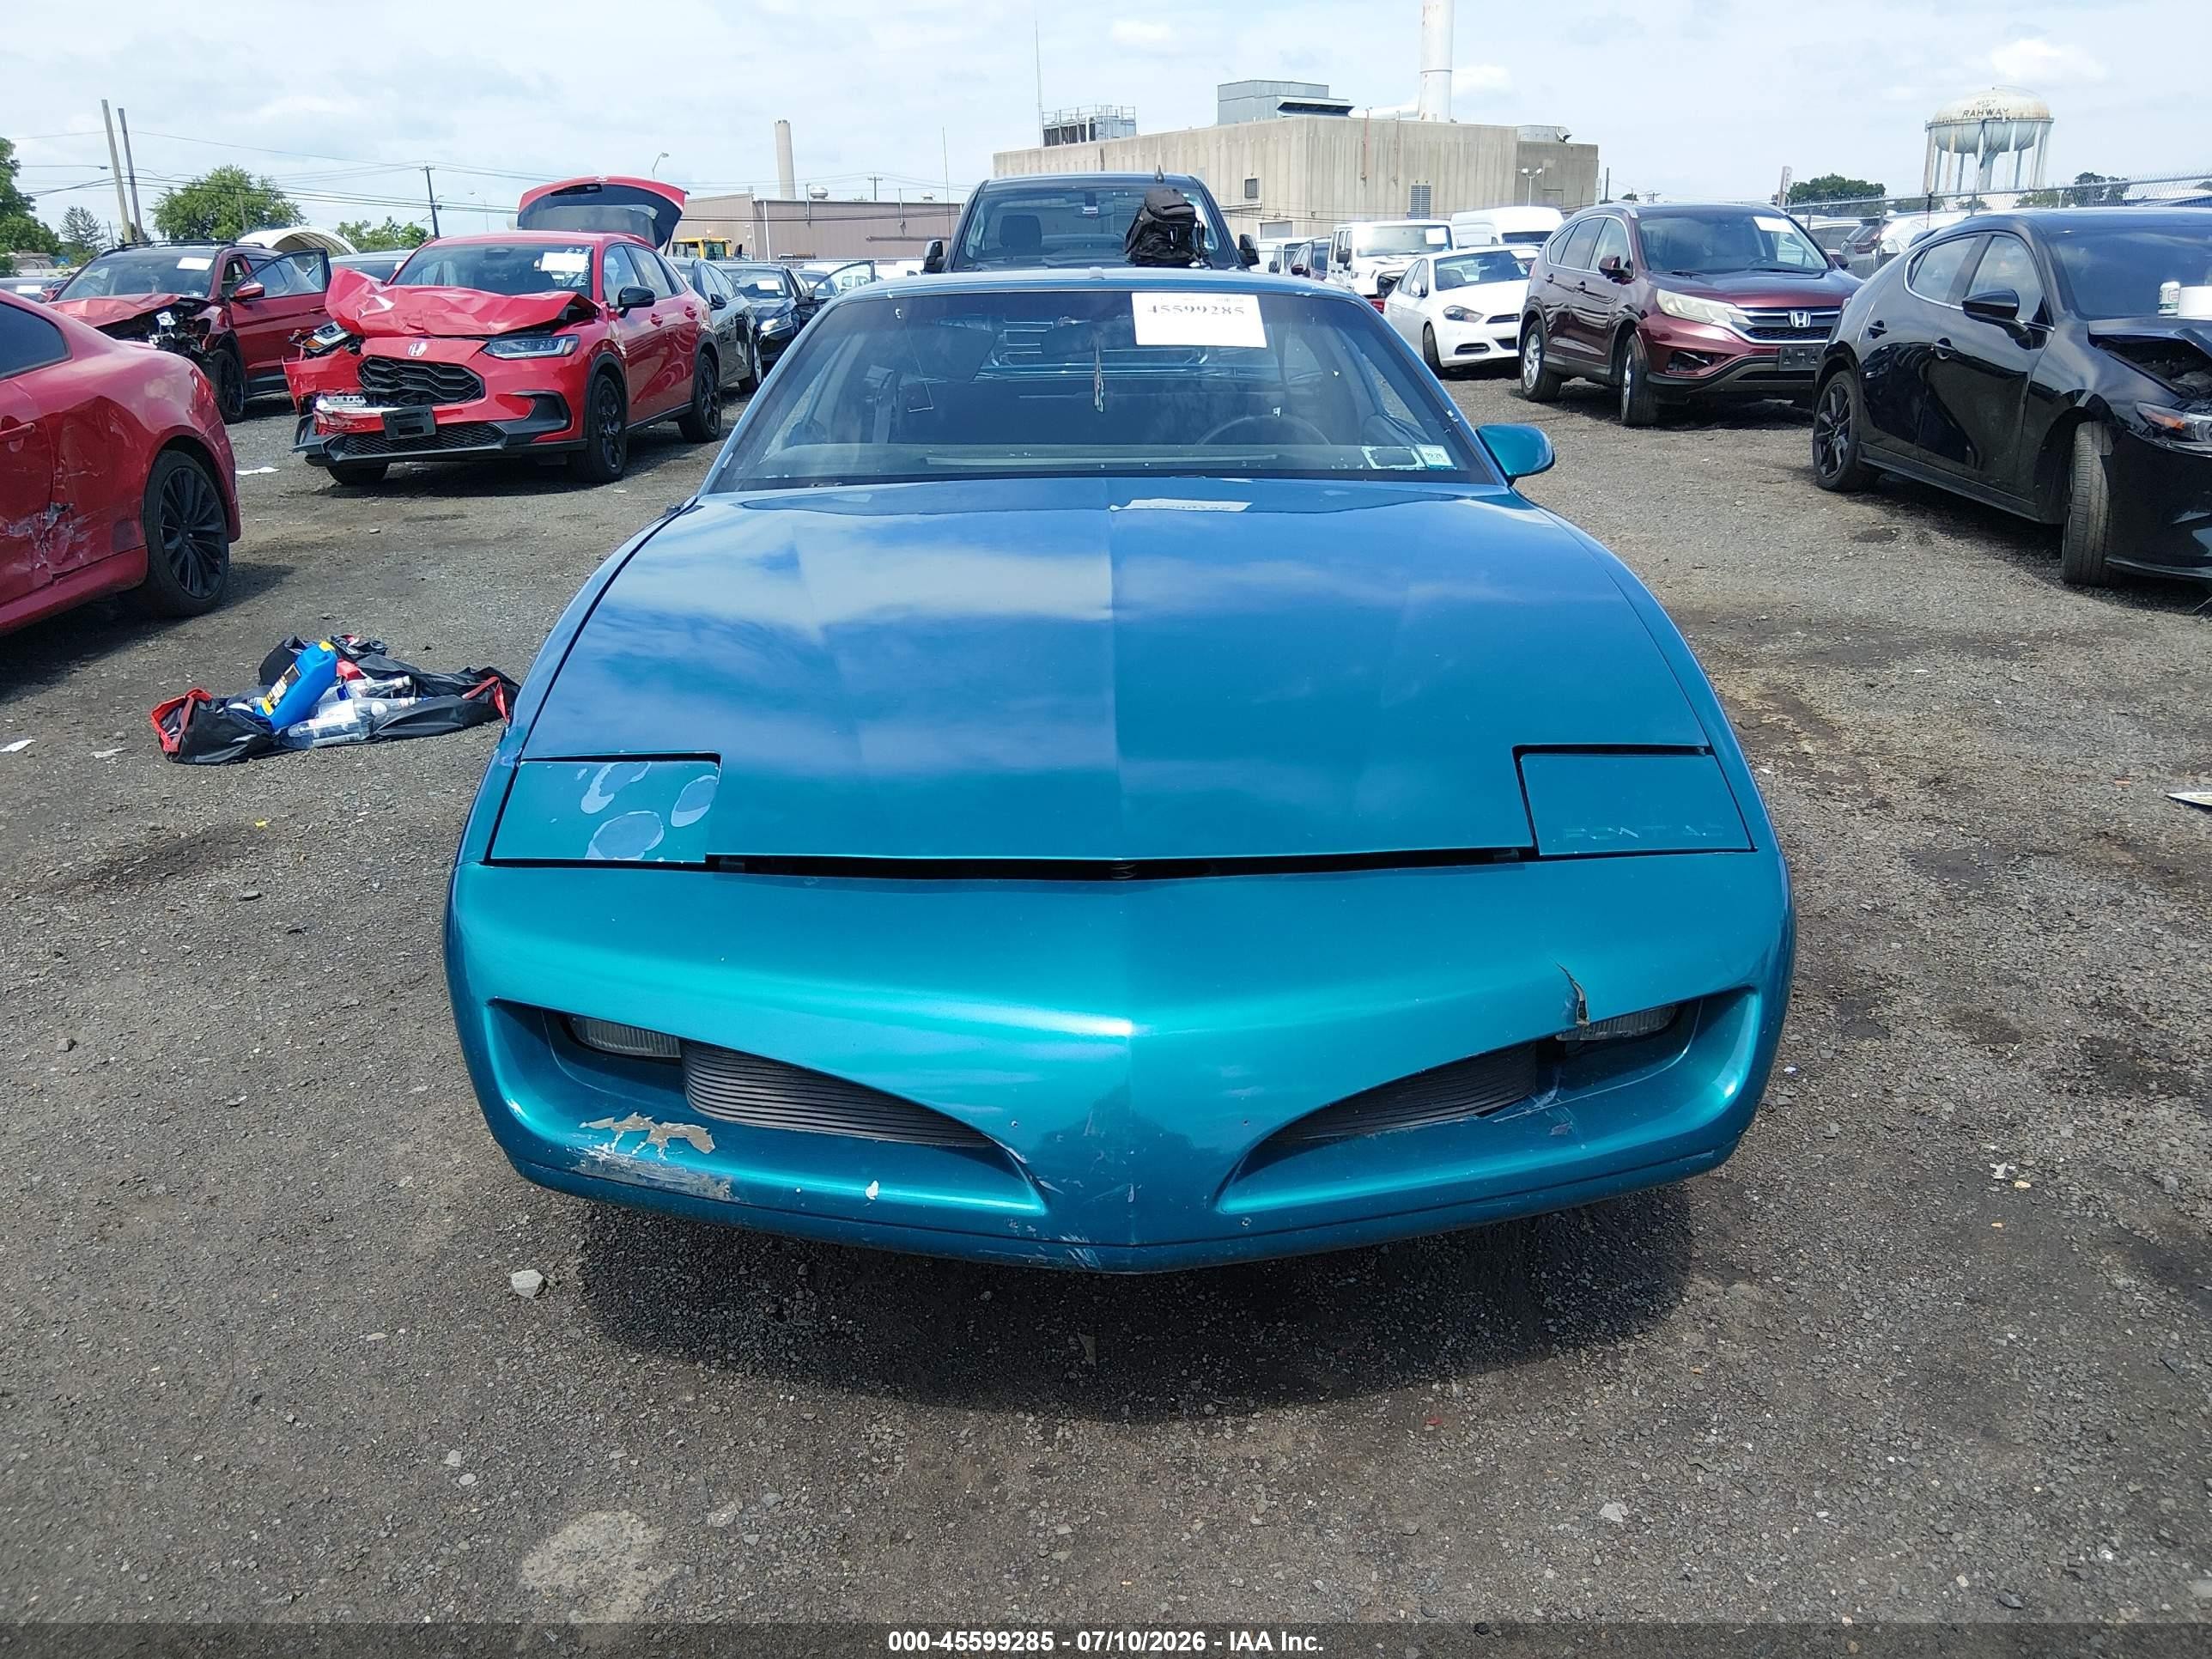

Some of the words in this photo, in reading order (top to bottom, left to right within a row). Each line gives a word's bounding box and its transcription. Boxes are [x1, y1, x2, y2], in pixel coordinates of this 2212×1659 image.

[1963, 108, 2009, 118] RAHWAY
[1147, 305, 1244, 315] 45599285
[1562, 822, 1724, 842] PONTAC
